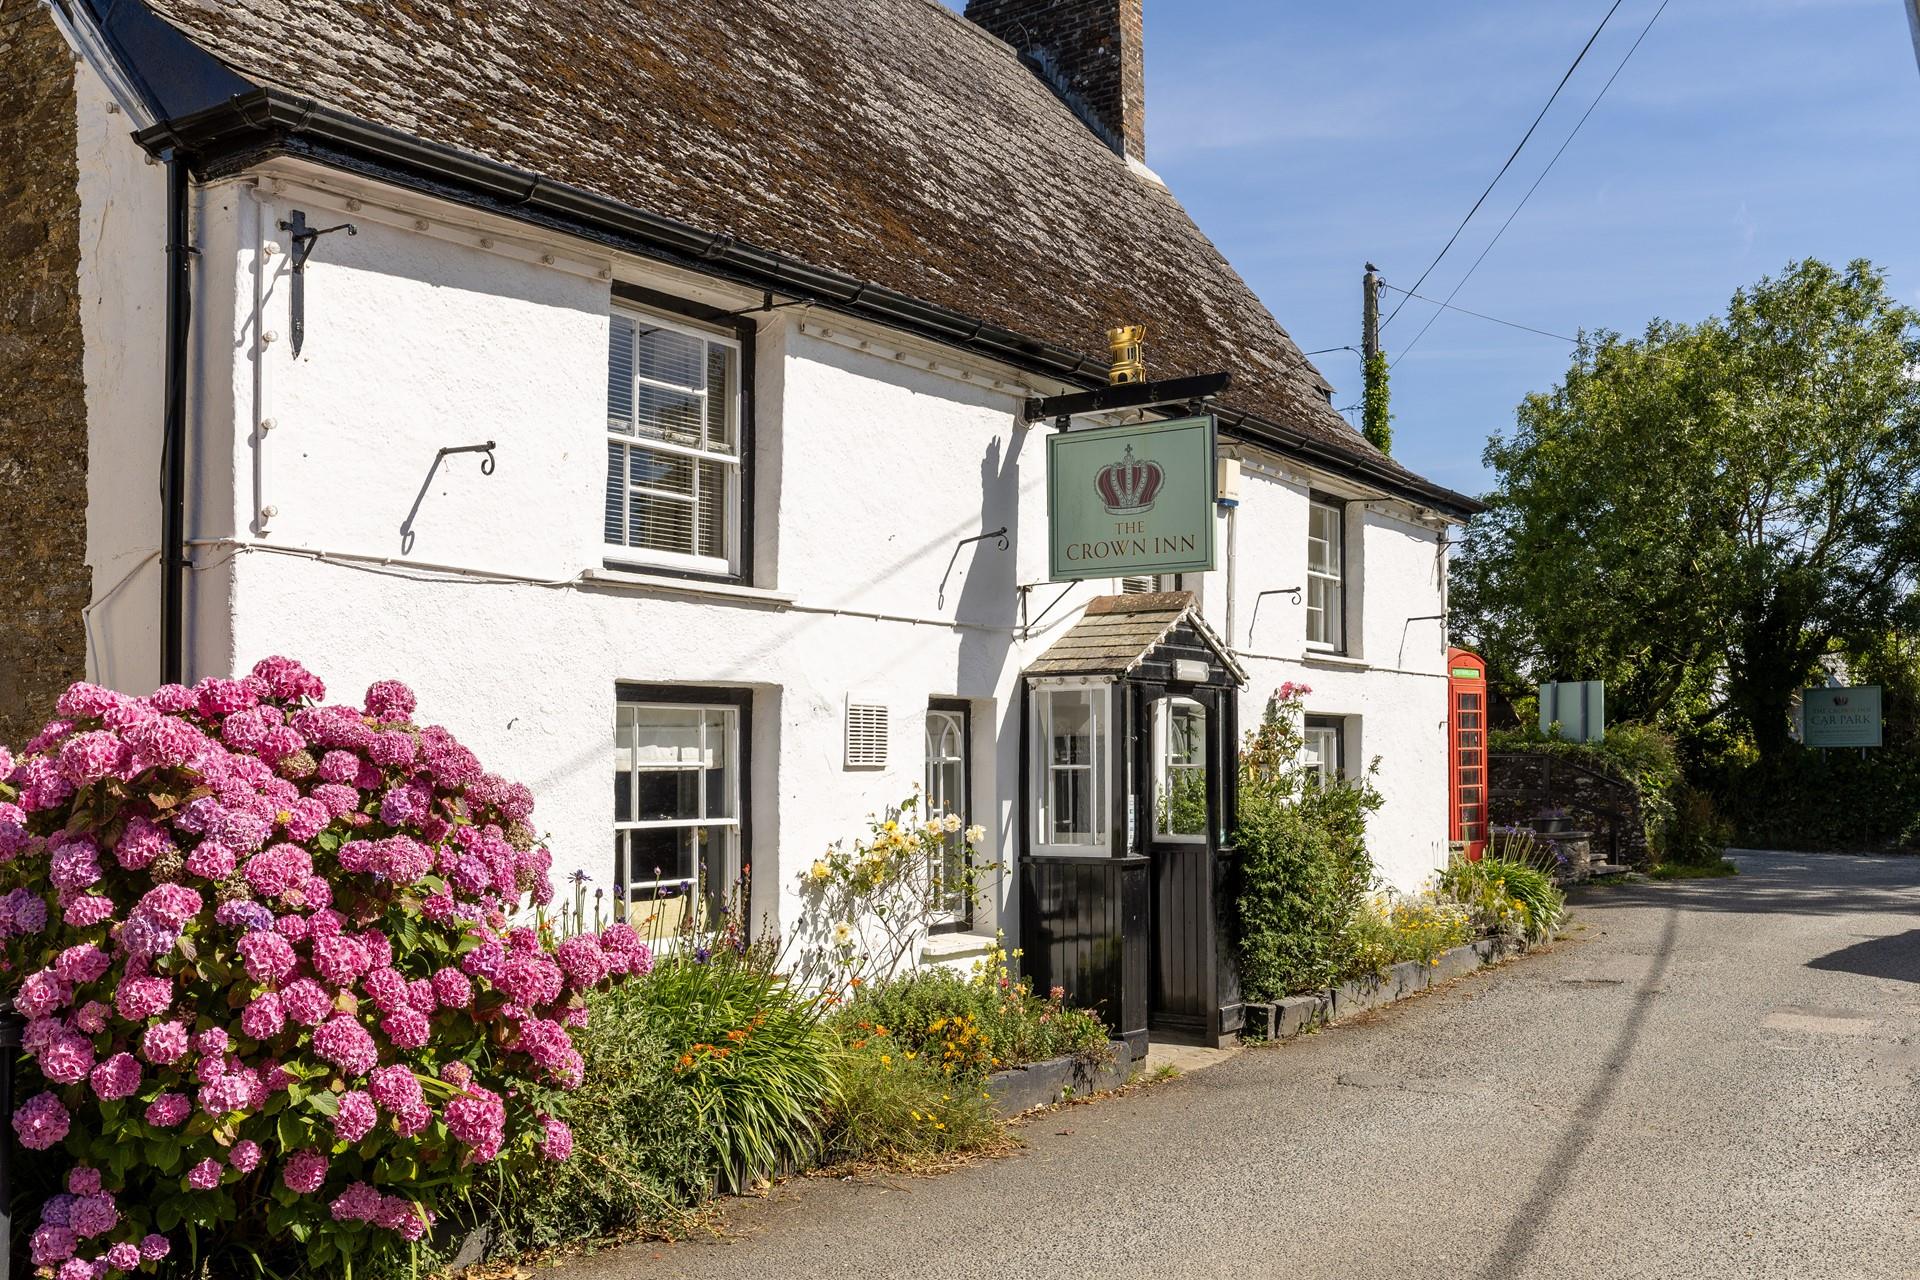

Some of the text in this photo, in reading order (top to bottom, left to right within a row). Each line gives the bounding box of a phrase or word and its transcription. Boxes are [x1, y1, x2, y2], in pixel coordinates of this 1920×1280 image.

[1114, 520, 1145, 535] THE
[1066, 534, 1195, 561] CROWN INN
[1811, 714, 1871, 725] CAR PARK
